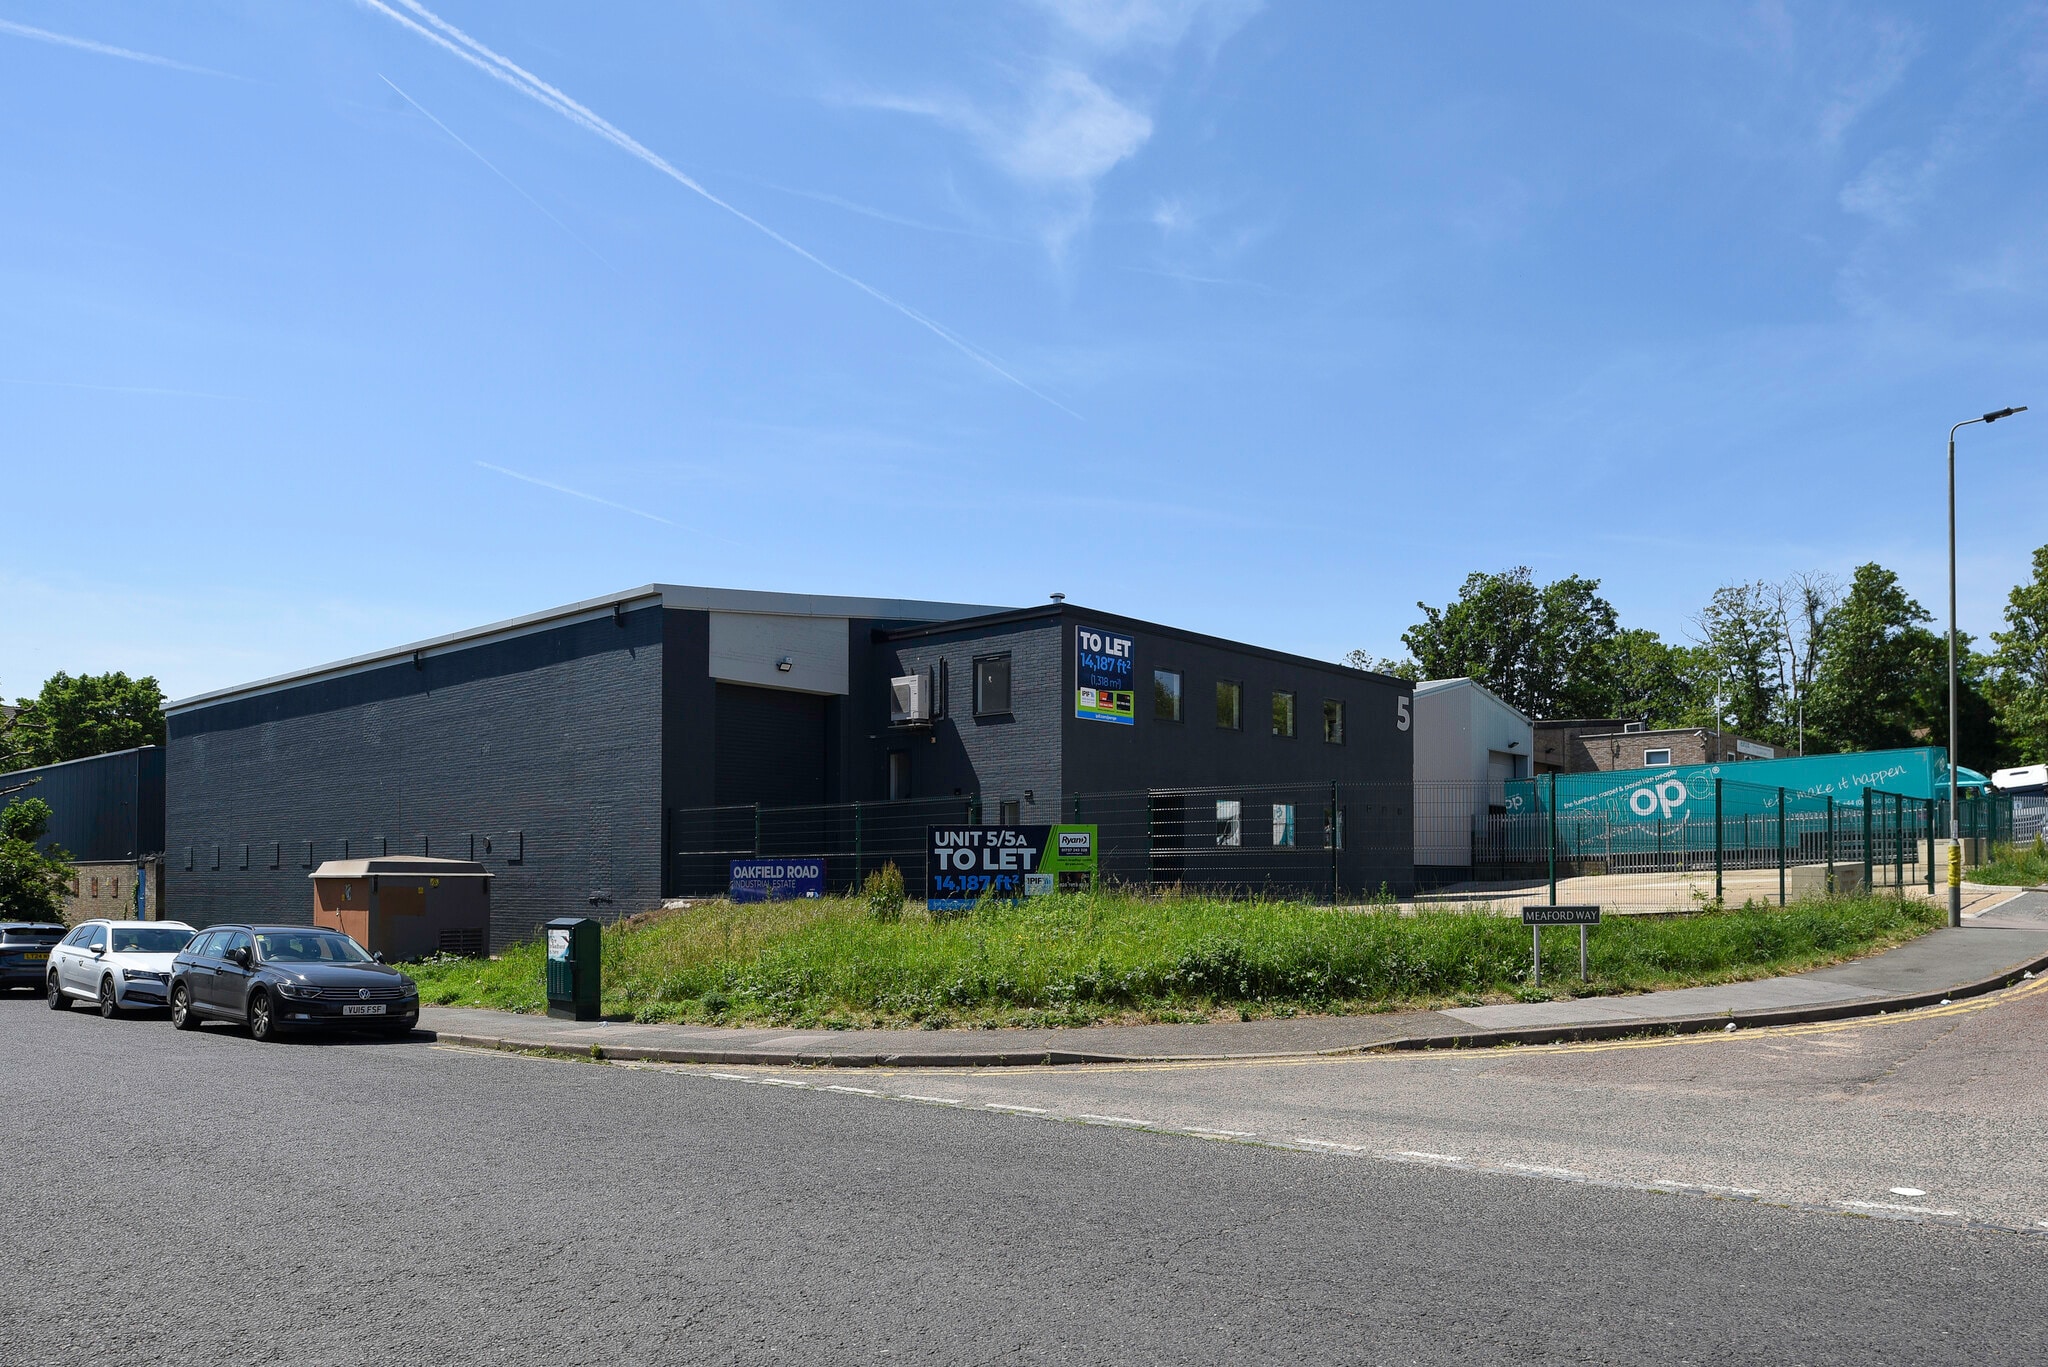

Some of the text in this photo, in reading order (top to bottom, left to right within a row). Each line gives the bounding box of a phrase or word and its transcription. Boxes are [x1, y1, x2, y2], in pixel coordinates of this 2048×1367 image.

[1080, 631, 1131, 657] TO LET
[1080, 652, 1115, 672] 14,187
[1396, 695, 1411, 732] 5
[1655, 769, 1678, 782] people
[1796, 783, 1835, 800] make
[1838, 777, 1849, 790] it
[1852, 765, 1907, 786] happen
[935, 831, 982, 847] UNIT
[1062, 836, 1081, 845] Ryan
[934, 848, 1037, 870] TO LET
[733, 865, 819, 879] OAKFIELD ROAD
[732, 879, 796, 889] INDUSTRIAL ESTATE
[934, 875, 991, 893] 14,187
[1525, 910, 1598, 921] MEAFORD WAY
